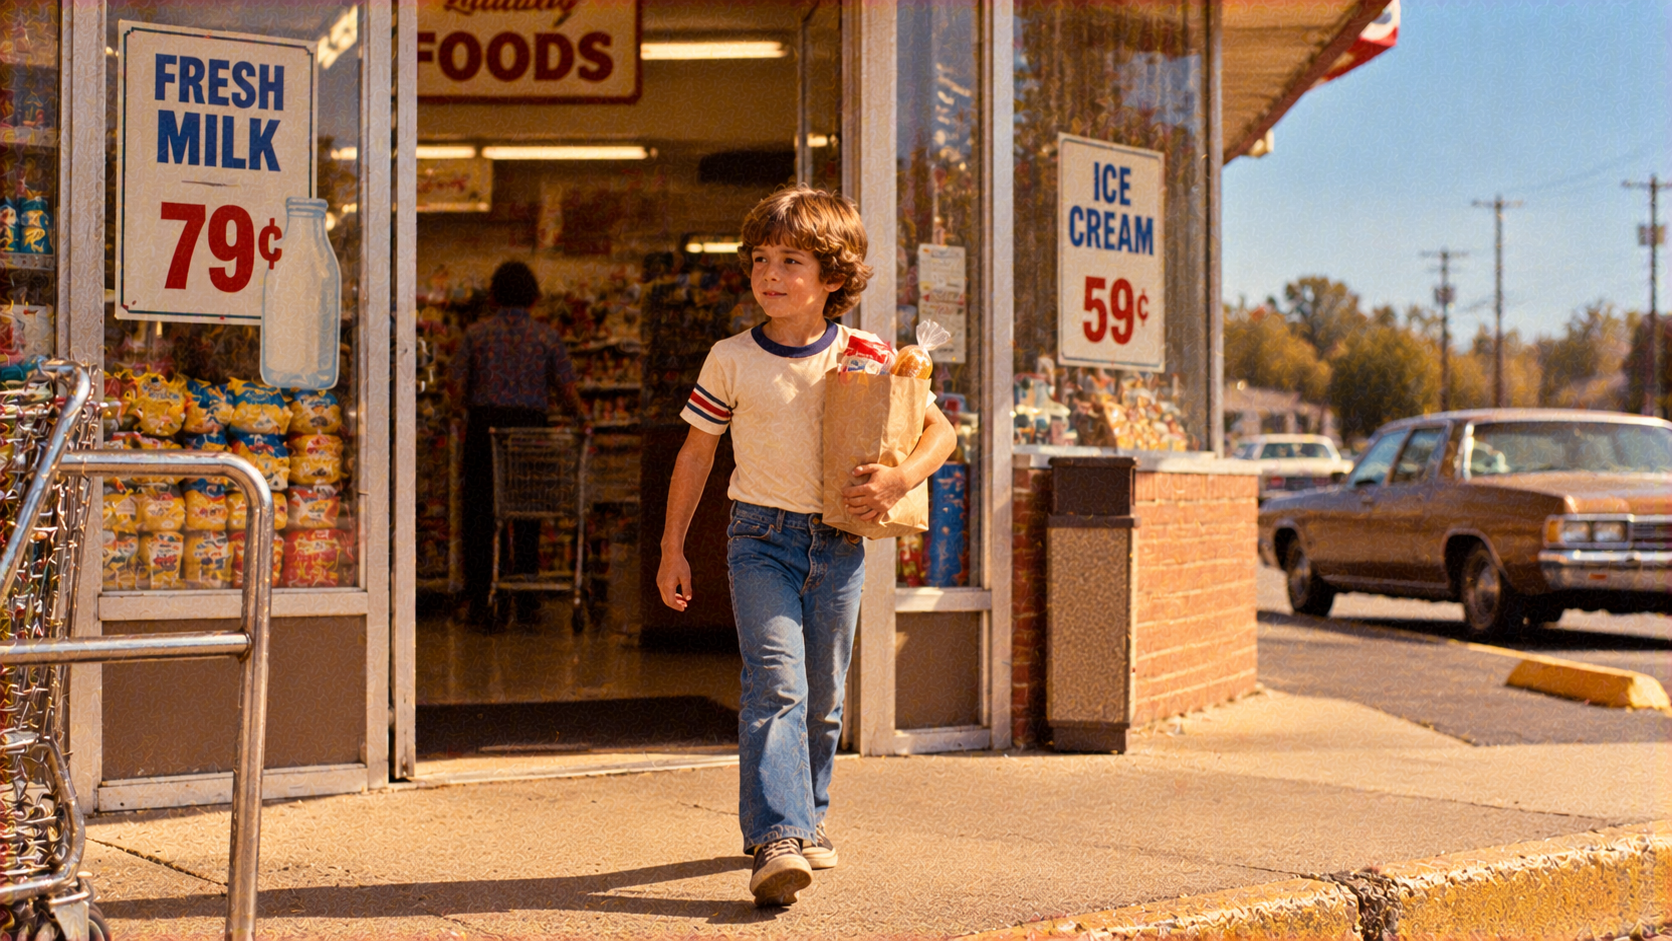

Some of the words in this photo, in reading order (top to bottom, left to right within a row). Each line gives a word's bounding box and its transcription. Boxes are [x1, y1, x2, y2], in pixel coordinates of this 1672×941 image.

[154, 53, 285, 111] FRESH
[156, 109, 282, 172] MILK
[1093, 161, 1132, 207] ICE
[160, 201, 283, 294] 79¢
[1068, 205, 1154, 256] CREAM
[1082, 275, 1149, 345] 59¢
